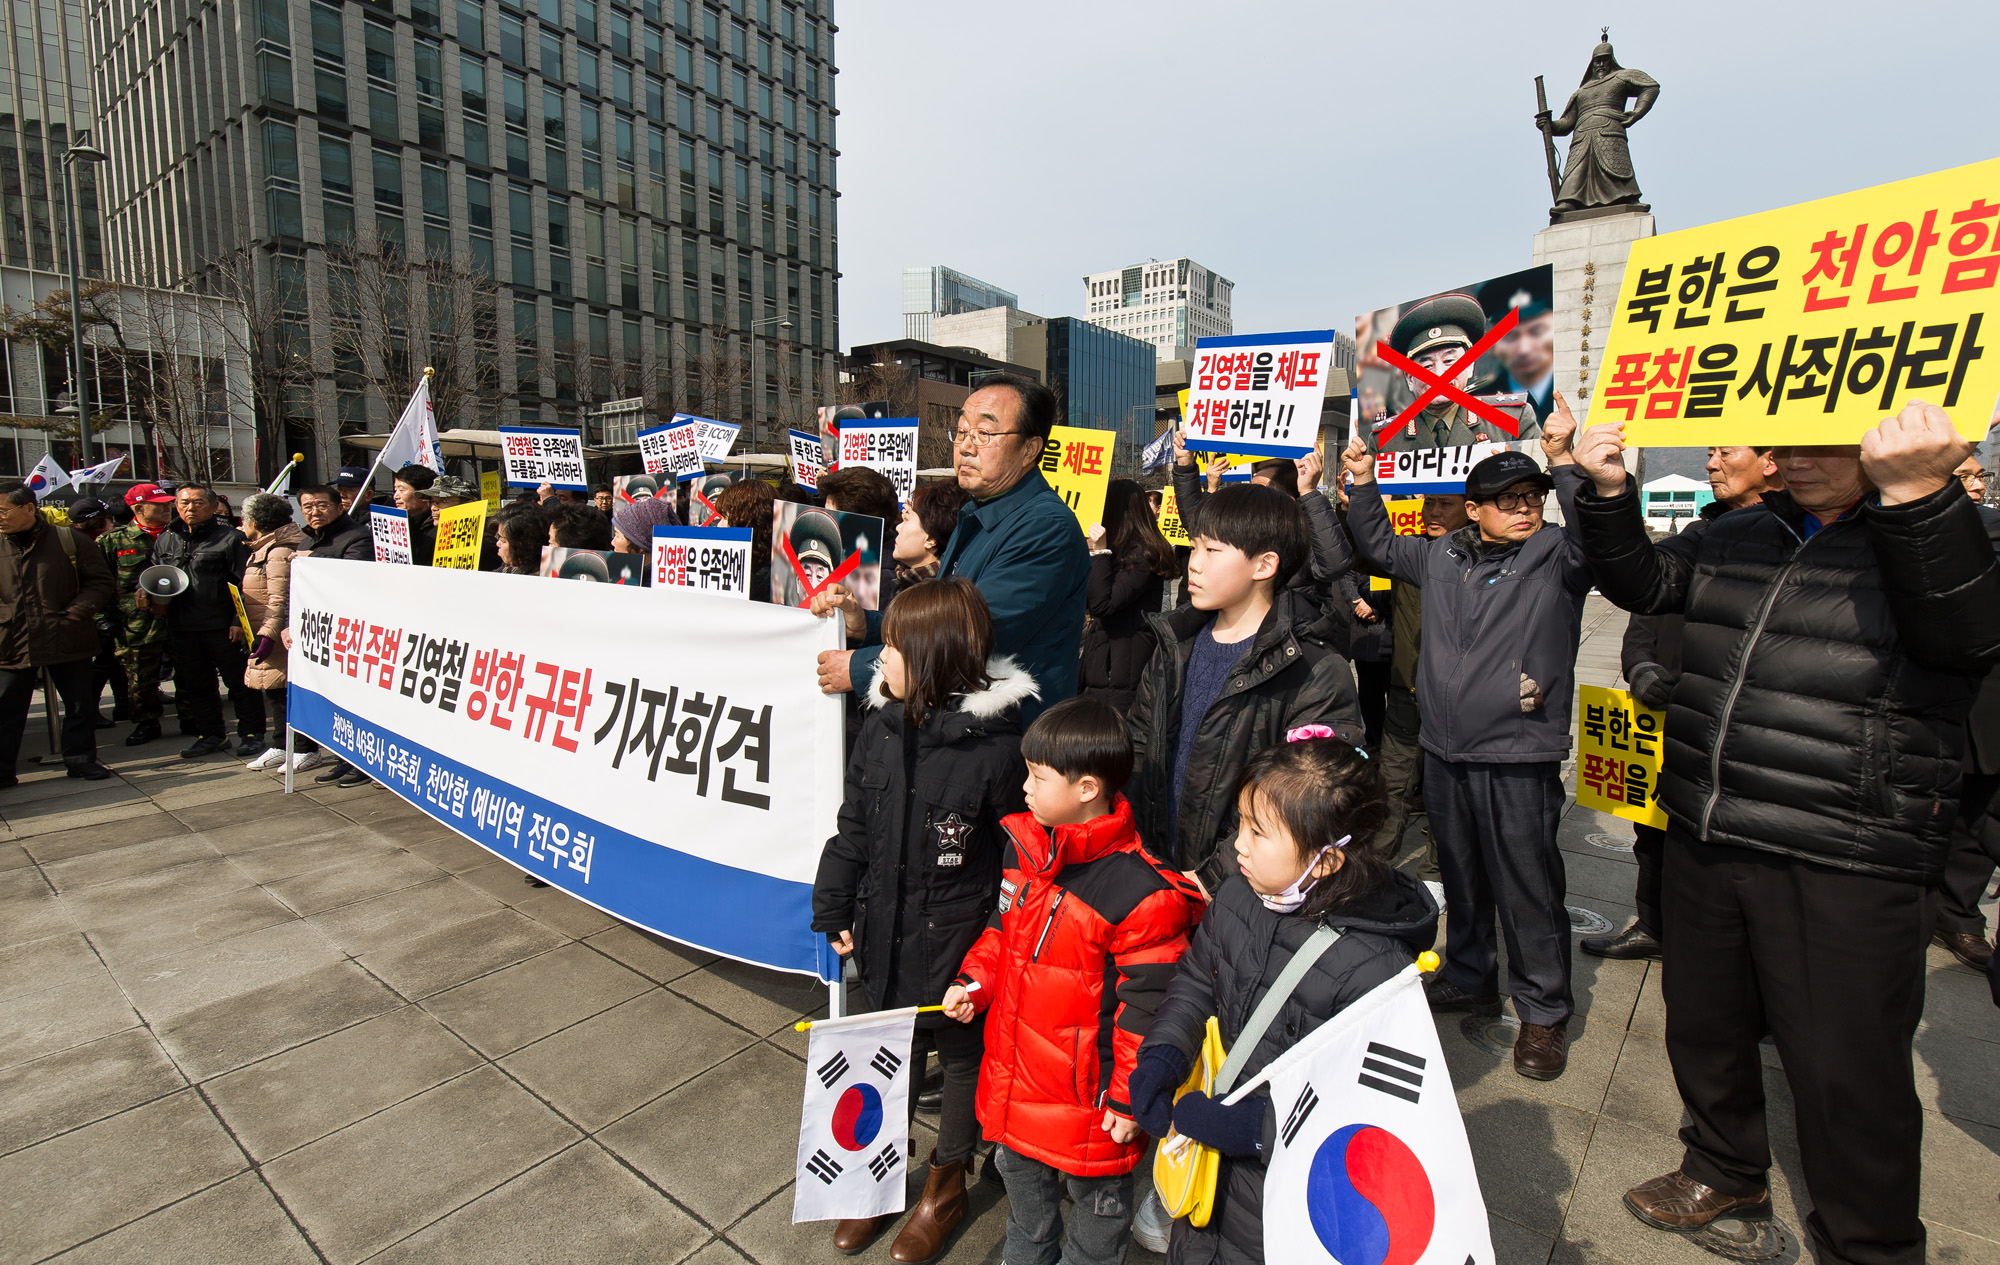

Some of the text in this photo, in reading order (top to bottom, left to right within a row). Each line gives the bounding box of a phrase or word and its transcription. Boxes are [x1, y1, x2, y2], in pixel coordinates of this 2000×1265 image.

[1627, 198, 2000, 334] 북한은 천안함
[1198, 350, 1321, 391] 김영철을 체포
[1604, 312, 1984, 422] 폭침을 사죄하라
[506, 436, 579, 459] 김영철은 유족앞에
[641, 434, 668, 457] 북한은
[668, 426, 696, 451] 천안함
[794, 439, 822, 465] 북한은
[843, 431, 914, 463] 김영철은 유족앞에
[1062, 442, 1104, 476] 체포
[510, 459, 583, 482] 무릎꿇고 사죄하라
[669, 449, 700, 474] 사죄하라
[797, 462, 820, 485] 폭침
[373, 515, 409, 548] 북한은 천안함
[437, 514, 482, 552] 김영철은 유족앞에
[657, 544, 746, 593] 김영철은 유족앞에
[300, 607, 334, 667] 천안함
[333, 617, 366, 679] 폭침
[362, 625, 403, 690] 주범
[399, 633, 469, 714] 김영철
[466, 648, 525, 732] 방한
[523, 661, 593, 754] 규탄
[594, 677, 773, 811] 기자회견
[1584, 703, 1658, 757] 북한은
[332, 711, 596, 885] 천안함 46용사 유족회, 천안함 예비역 전우회
[1583, 753, 1649, 809] 폭침을
